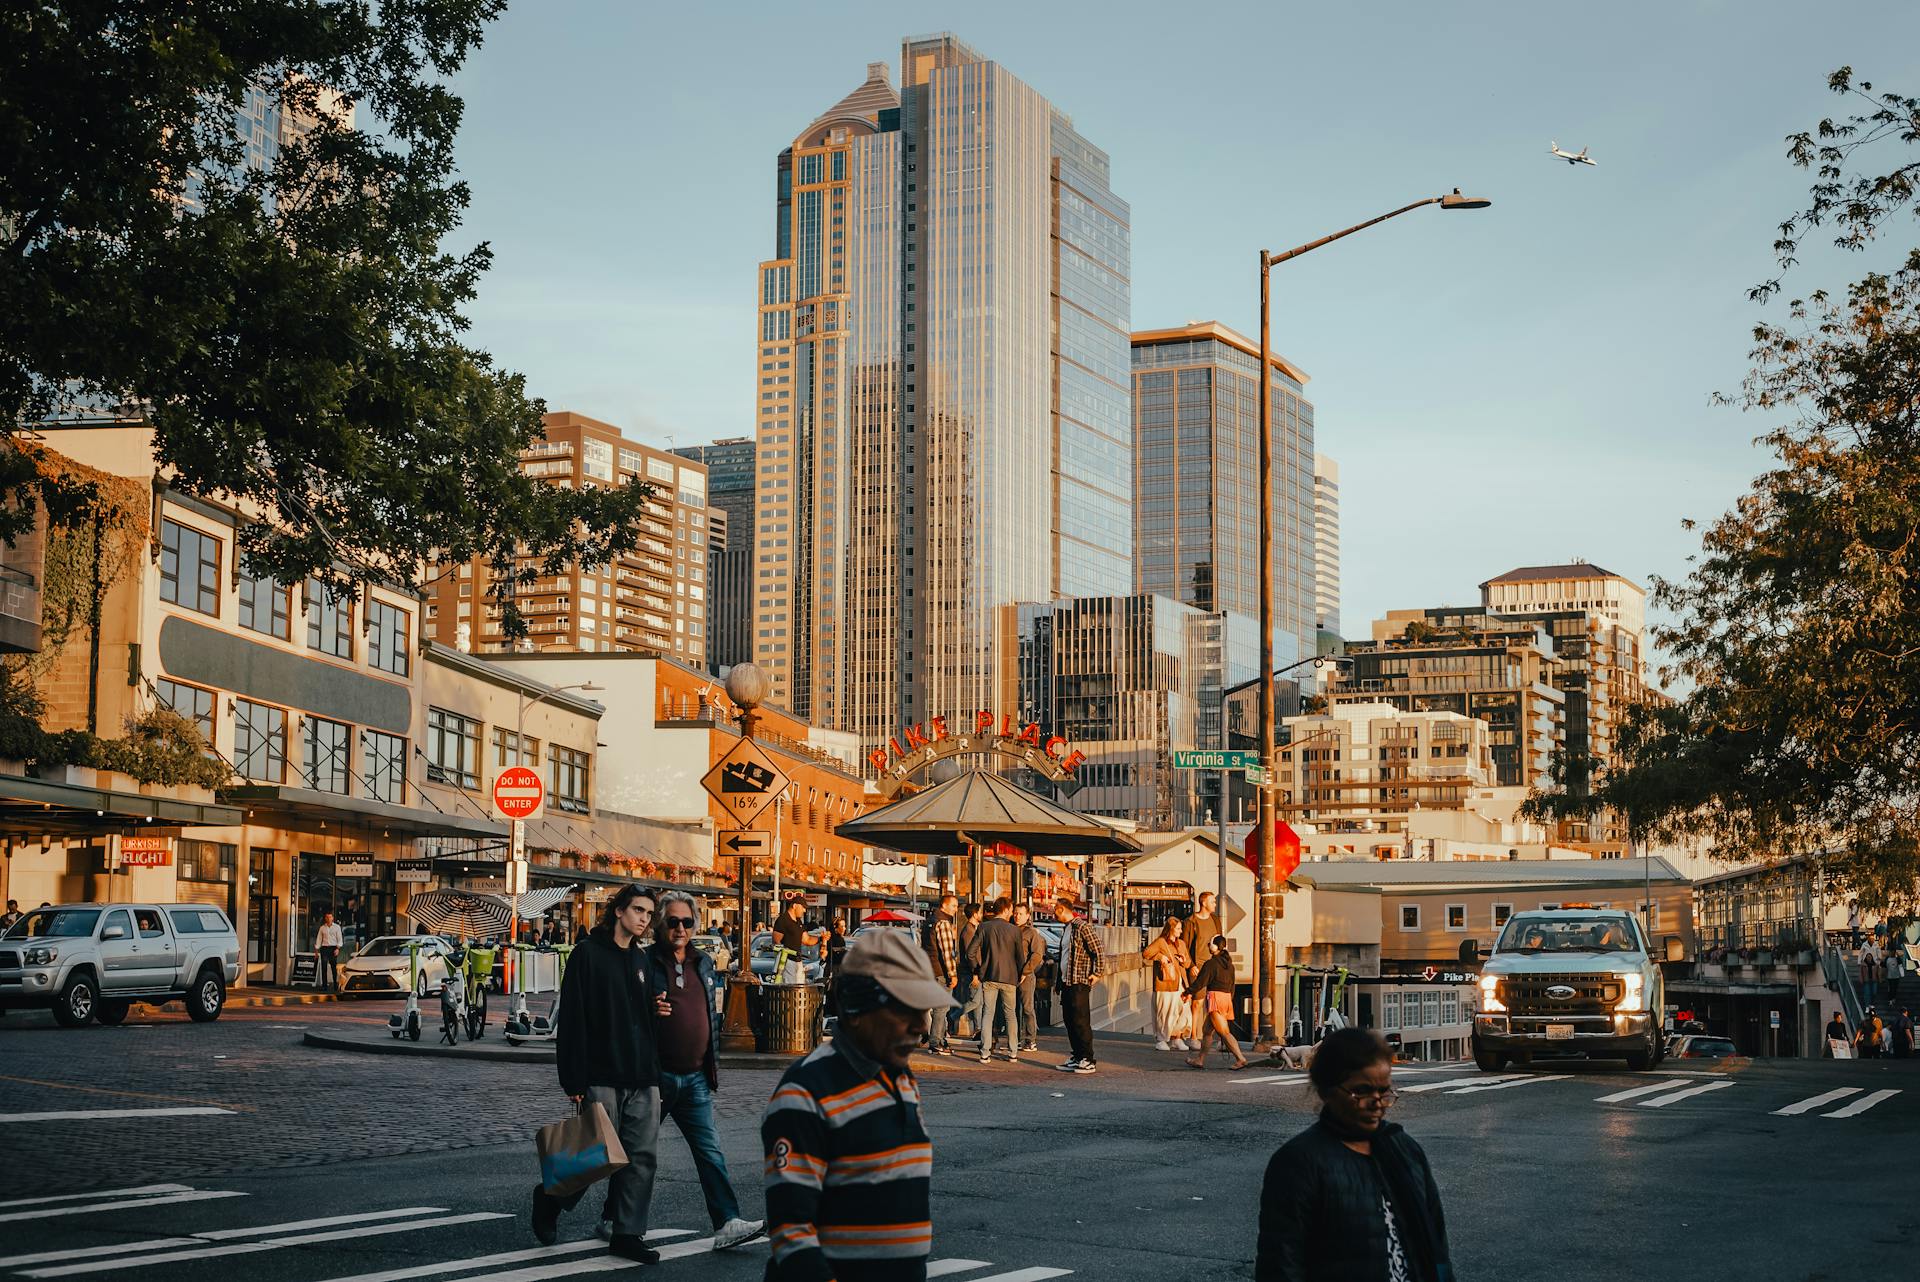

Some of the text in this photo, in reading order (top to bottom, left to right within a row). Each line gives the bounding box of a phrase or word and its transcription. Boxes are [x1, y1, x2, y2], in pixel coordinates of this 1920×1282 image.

[869, 711, 1087, 773] PIKE PLACE
[893, 738, 1065, 780] MARKET
[1178, 752, 1240, 768] Virginia St
[501, 777, 536, 785] DO NOT
[504, 800, 532, 808] ENTER
[734, 796, 757, 808] 16%
[1136, 887, 1160, 896] NORTH
[1443, 972, 1464, 981] Pike
